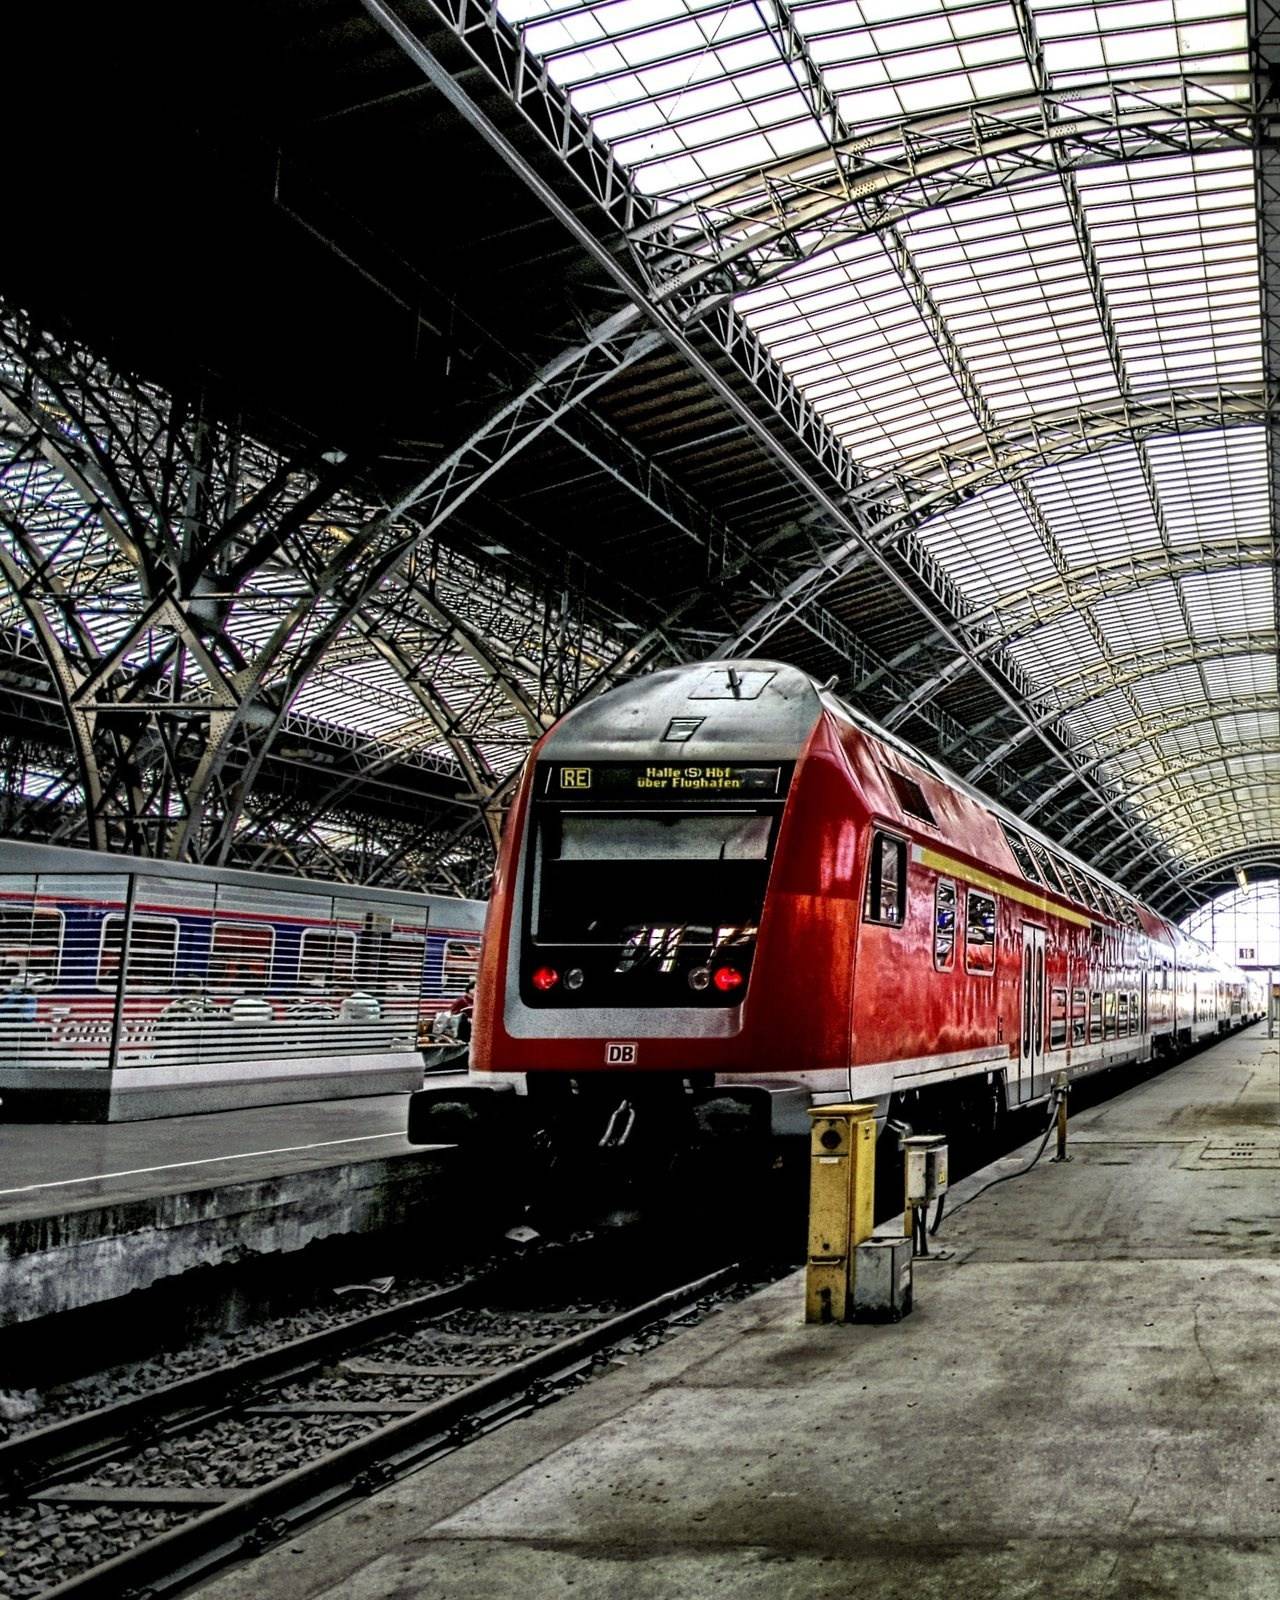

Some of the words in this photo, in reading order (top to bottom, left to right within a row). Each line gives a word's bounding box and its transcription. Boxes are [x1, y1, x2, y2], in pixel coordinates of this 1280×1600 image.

[563, 768, 588, 787] RE
[646, 767, 681, 778] Halle
[684, 767, 702, 778] (S)
[705, 767, 731, 778] Hbf
[637, 777, 668, 788] über
[671, 777, 741, 789] Flughafen
[608, 1045, 635, 1063] DB
